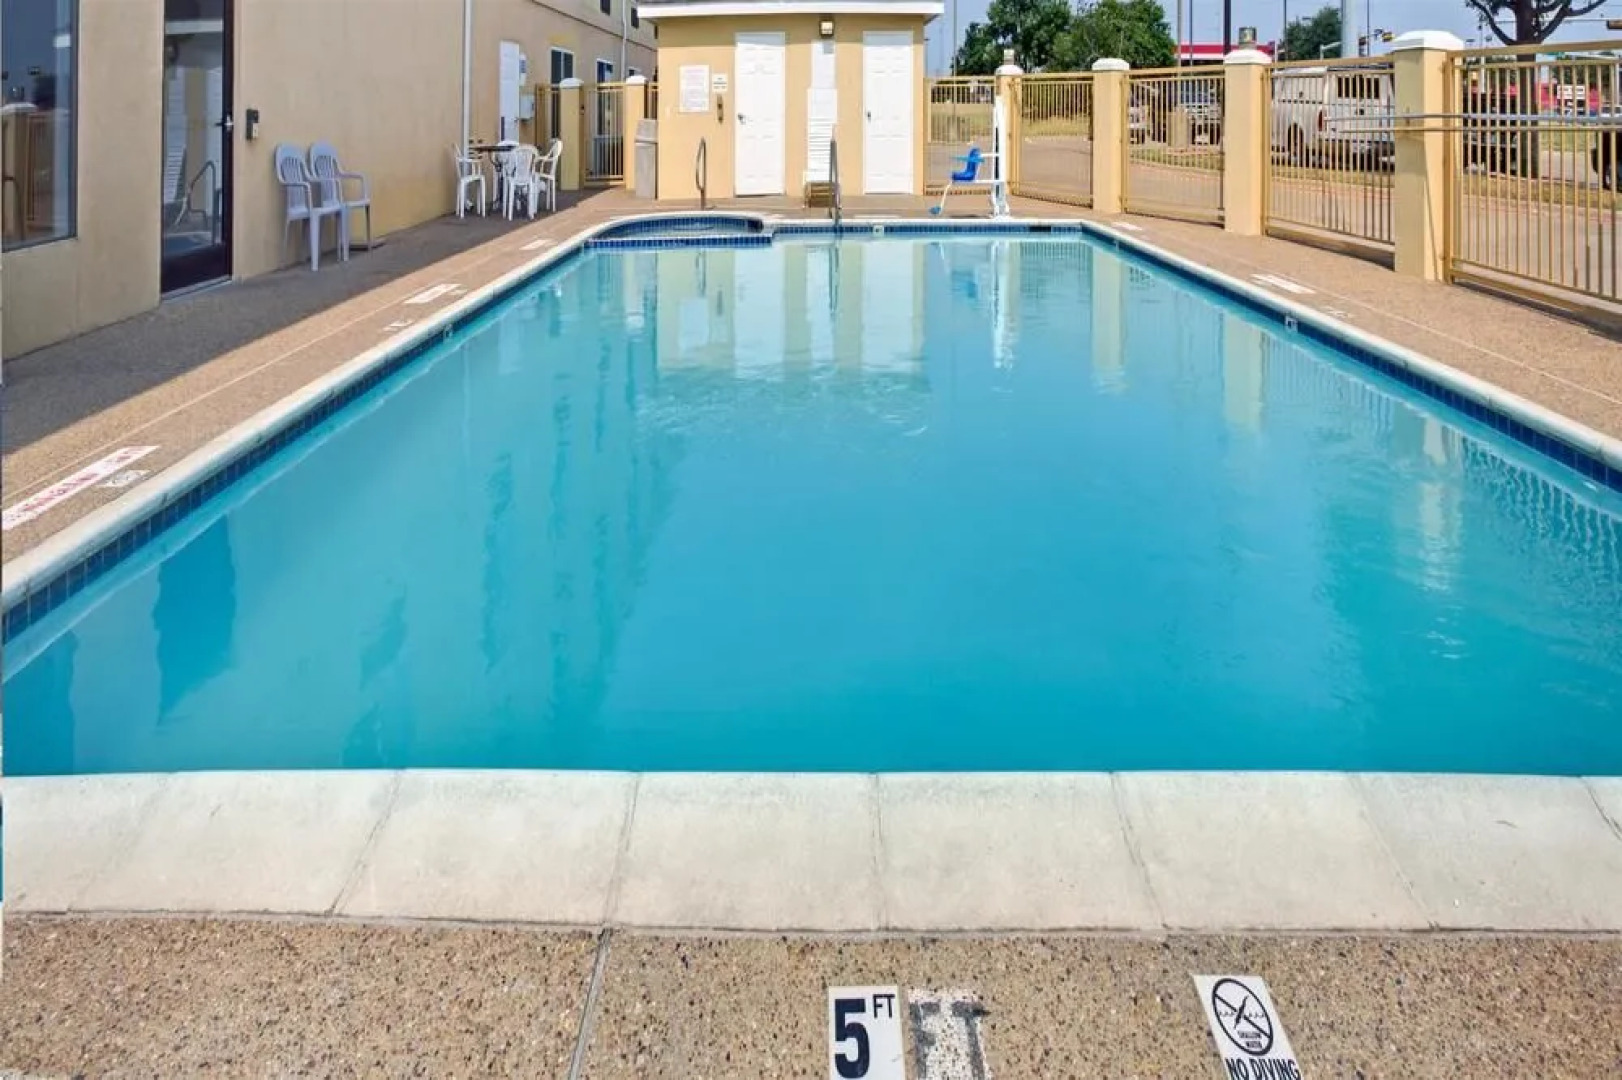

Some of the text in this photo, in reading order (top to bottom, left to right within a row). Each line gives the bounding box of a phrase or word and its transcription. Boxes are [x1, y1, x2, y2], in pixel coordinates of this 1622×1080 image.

[835, 993, 896, 1079] 5 FT
[1225, 1058, 1302, 1080] NO DIVING
